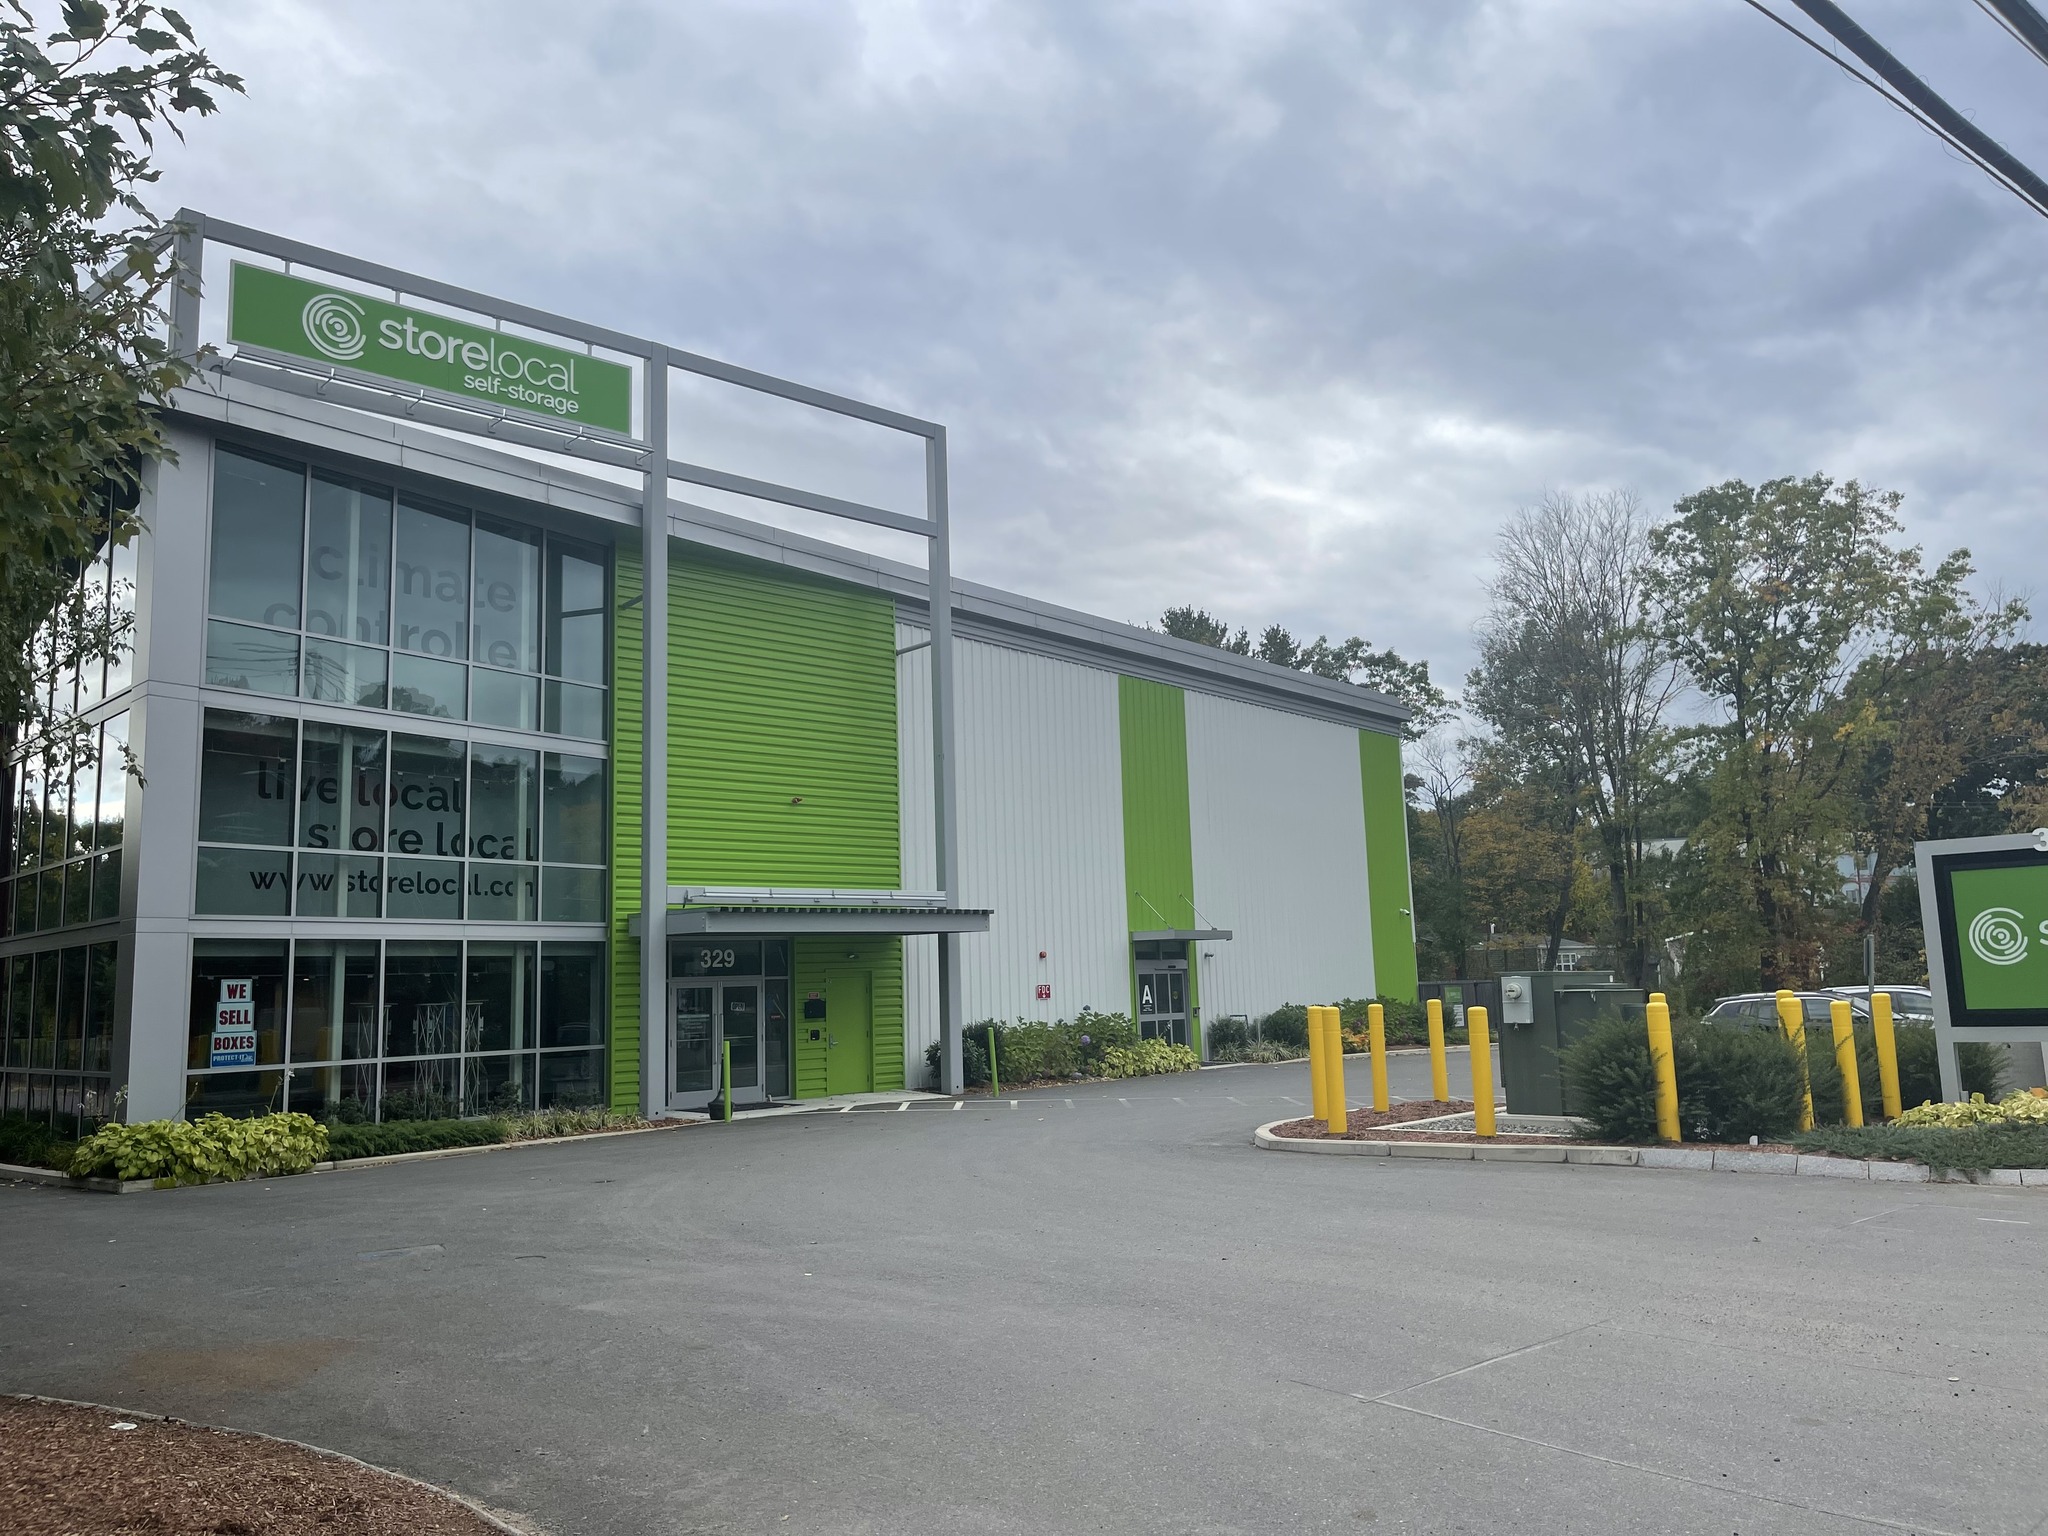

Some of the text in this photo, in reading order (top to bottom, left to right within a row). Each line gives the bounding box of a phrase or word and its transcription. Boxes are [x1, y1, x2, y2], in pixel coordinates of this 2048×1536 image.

[379, 316, 580, 395] storelocal
[464, 373, 580, 416] self-storage
[311, 543, 517, 613] cimate
[257, 760, 461, 813] live local
[307, 822, 535, 862] sore local
[700, 949, 735, 968] 329
[226, 984, 247, 999] WE
[1038, 985, 1050, 994] FDC
[1142, 984, 1153, 1004] A
[219, 1009, 251, 1025] SELL
[213, 1036, 254, 1050] BOXES
[213, 1054, 238, 1062] PROTECT
